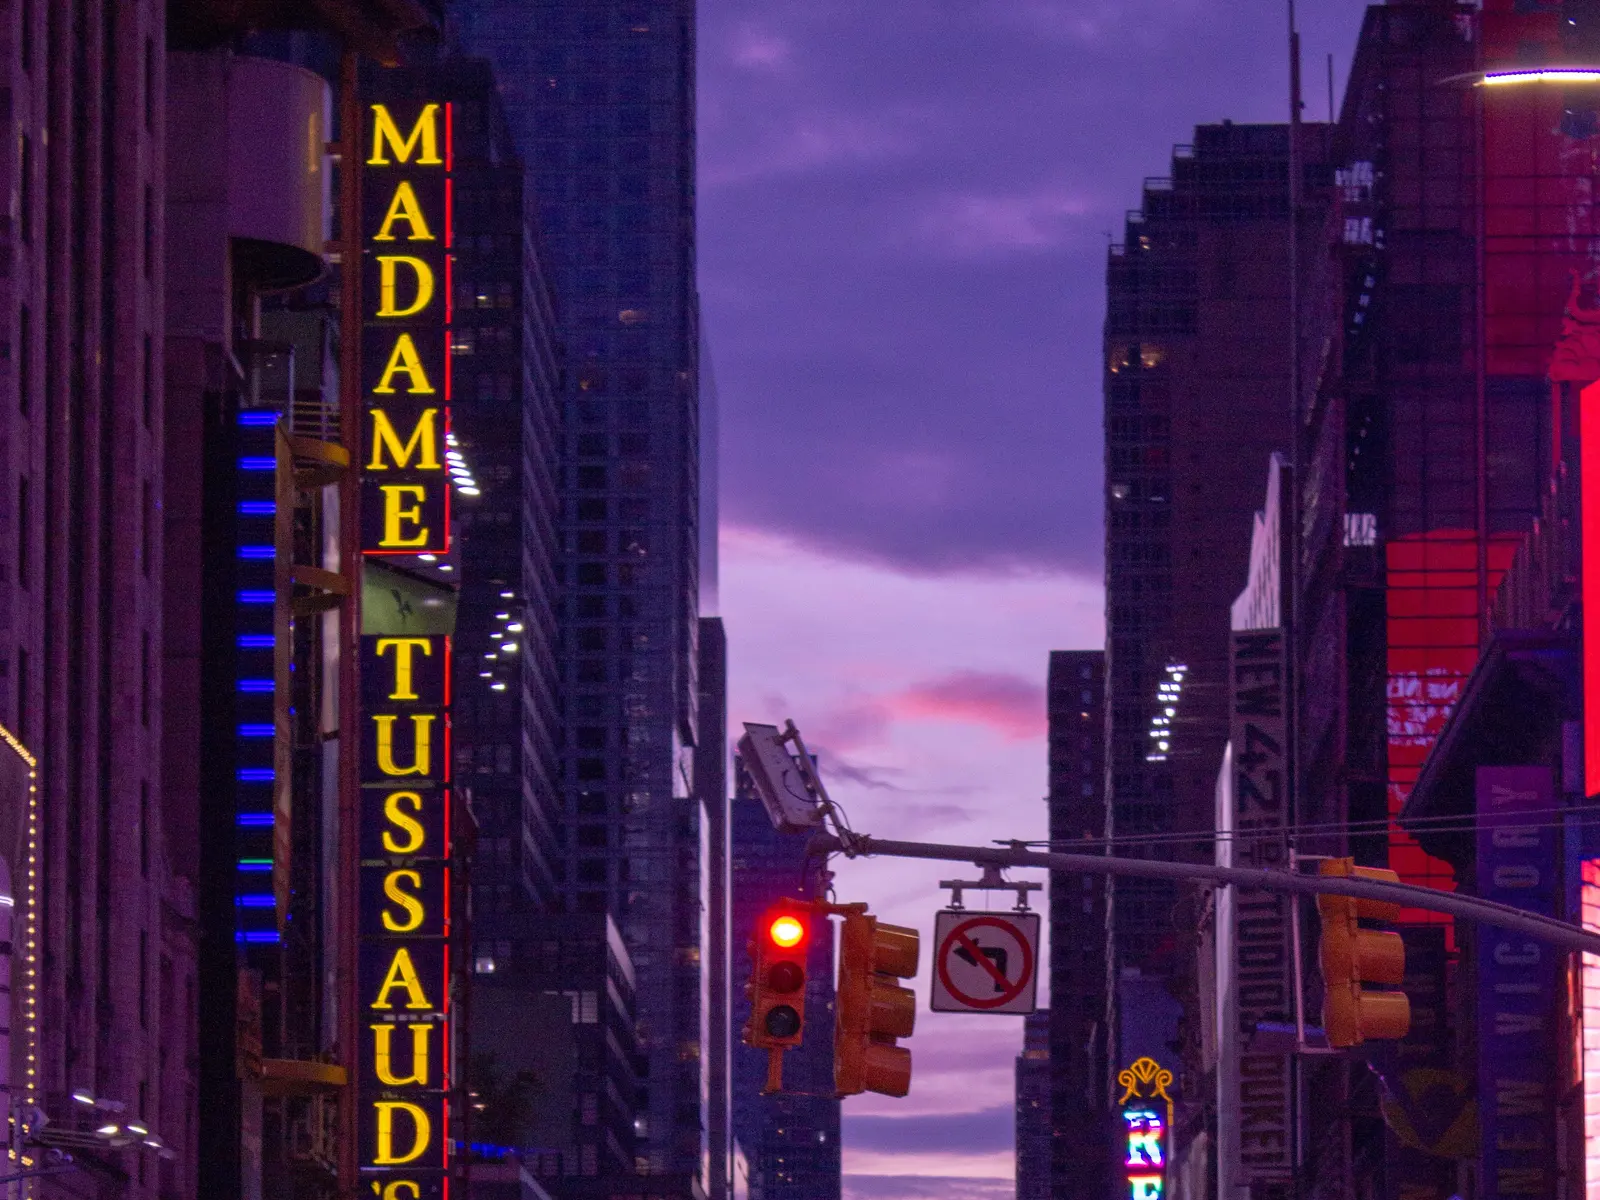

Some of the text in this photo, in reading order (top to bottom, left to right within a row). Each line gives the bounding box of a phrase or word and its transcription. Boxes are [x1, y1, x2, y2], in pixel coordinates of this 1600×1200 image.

[366, 103, 442, 548] MADAME
[1236, 634, 1281, 717] NEW
[1238, 722, 1282, 814] 42
[1238, 886, 1284, 1032] TUDIOS
[1491, 783, 1546, 1196] NEW VICORY
